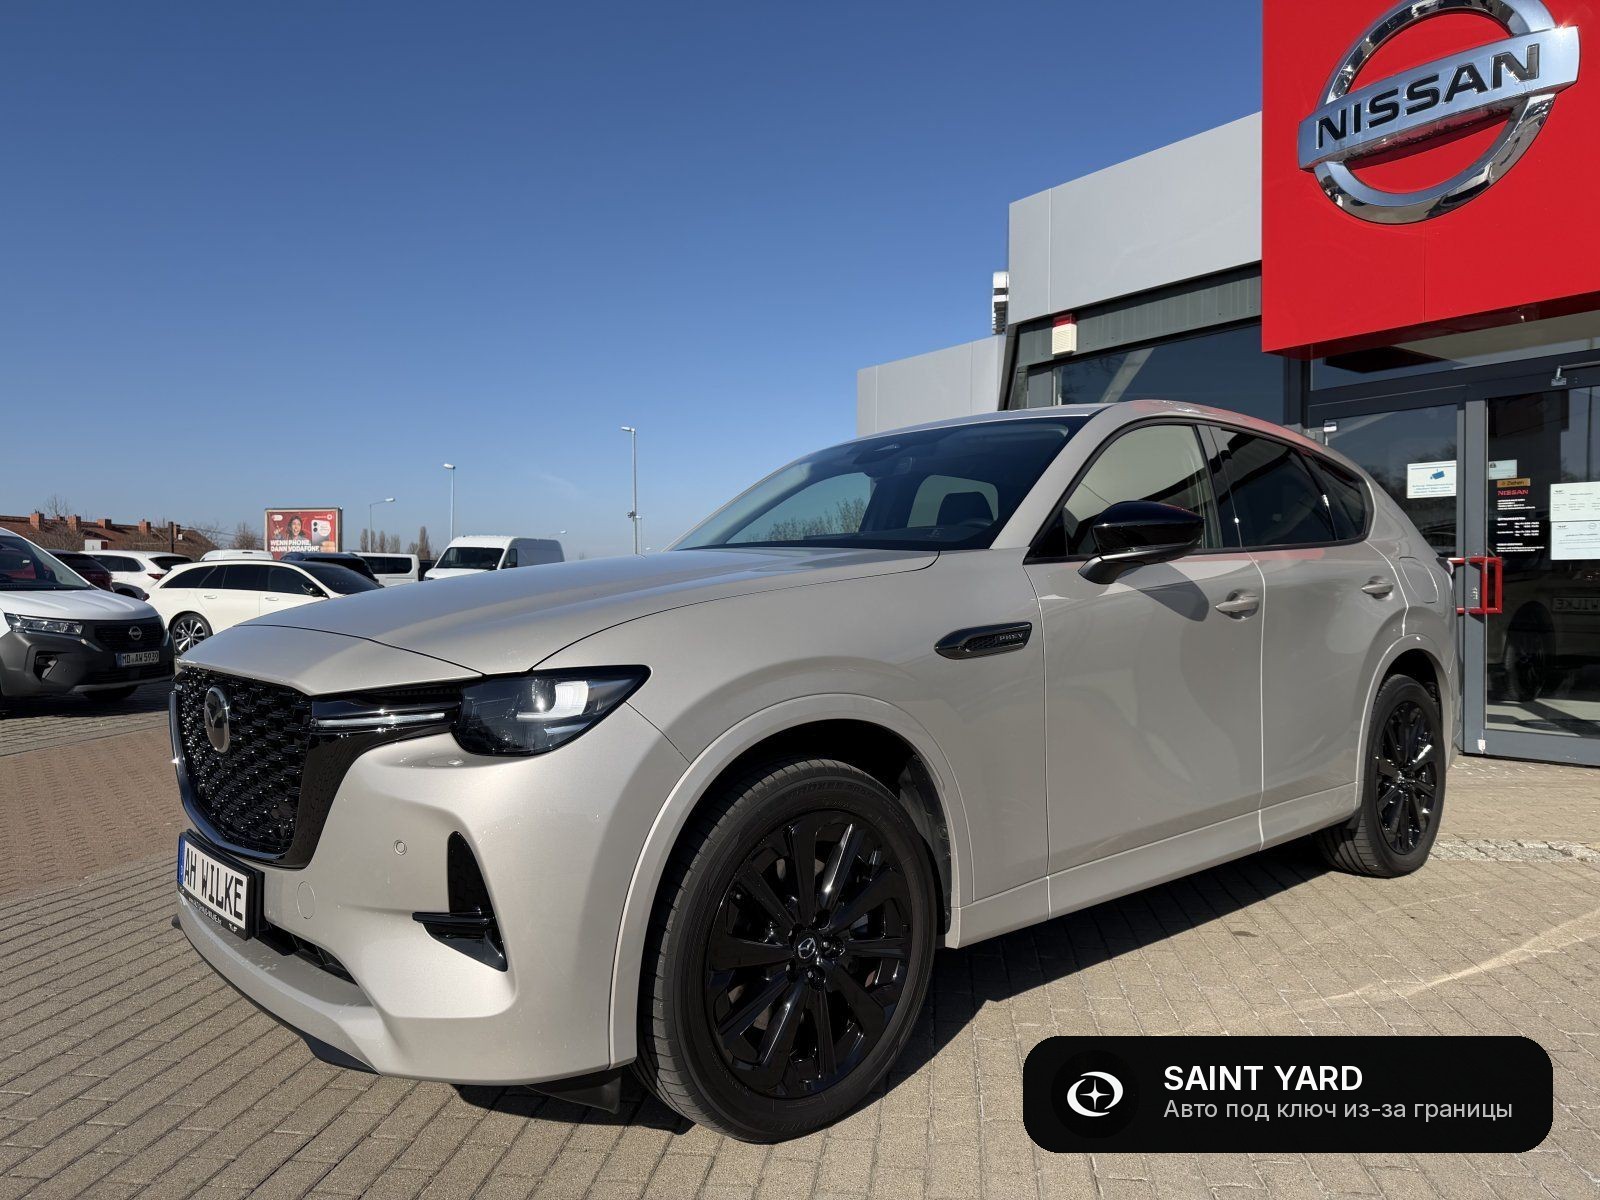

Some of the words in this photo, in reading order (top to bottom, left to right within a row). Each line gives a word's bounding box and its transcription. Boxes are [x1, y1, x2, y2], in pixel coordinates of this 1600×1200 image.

[1316, 43, 1540, 150] NISSAN
[1000, 633, 1023, 641] PHEV
[184, 847, 197, 891] AH
[201, 858, 244, 922] WILKE
